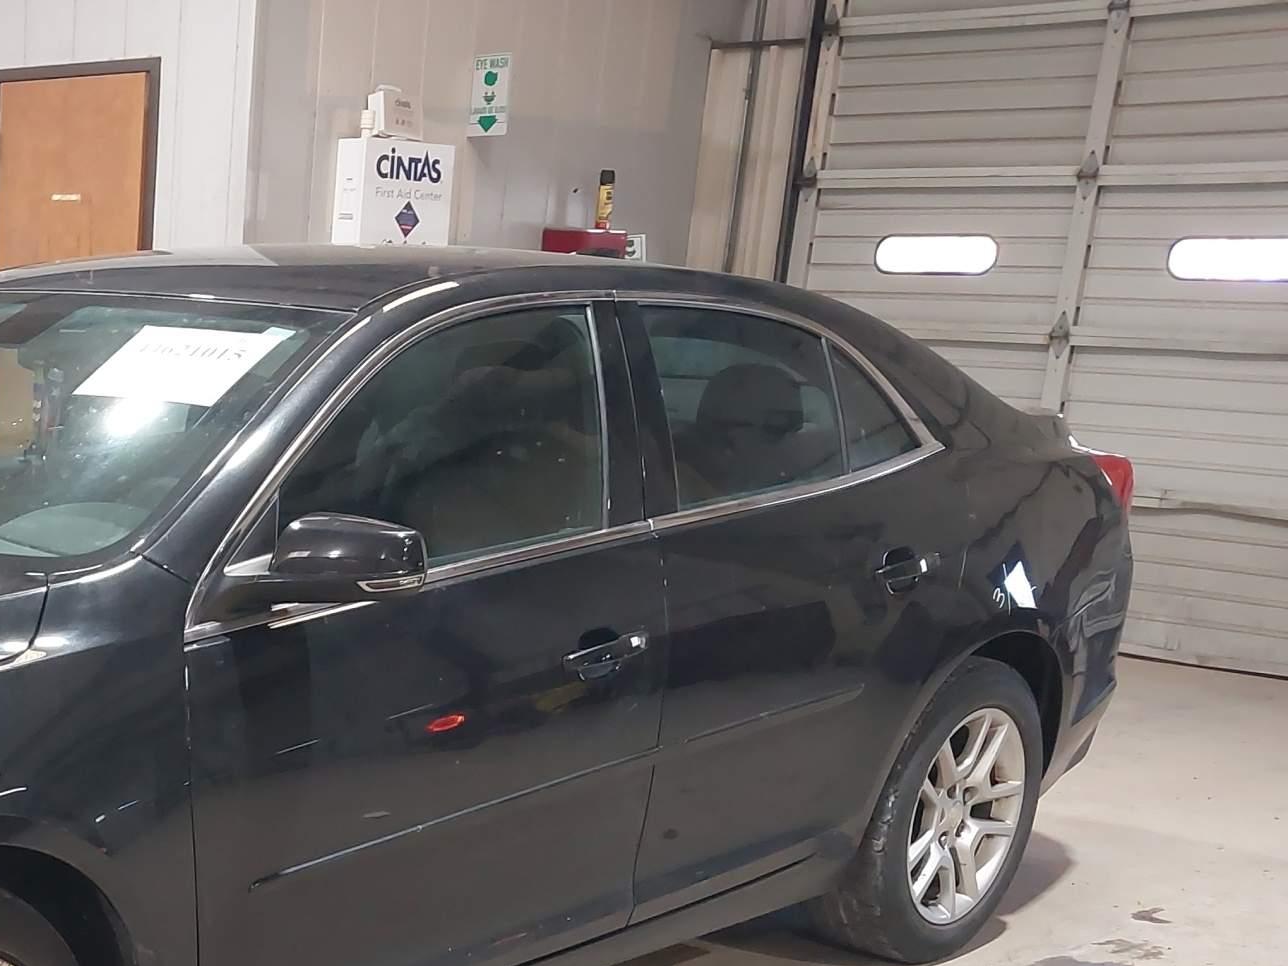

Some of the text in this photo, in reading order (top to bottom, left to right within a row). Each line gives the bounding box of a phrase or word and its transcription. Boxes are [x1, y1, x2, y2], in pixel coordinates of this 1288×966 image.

[475, 56, 509, 71] EYE WASH
[375, 186, 443, 201] First Aid Center
